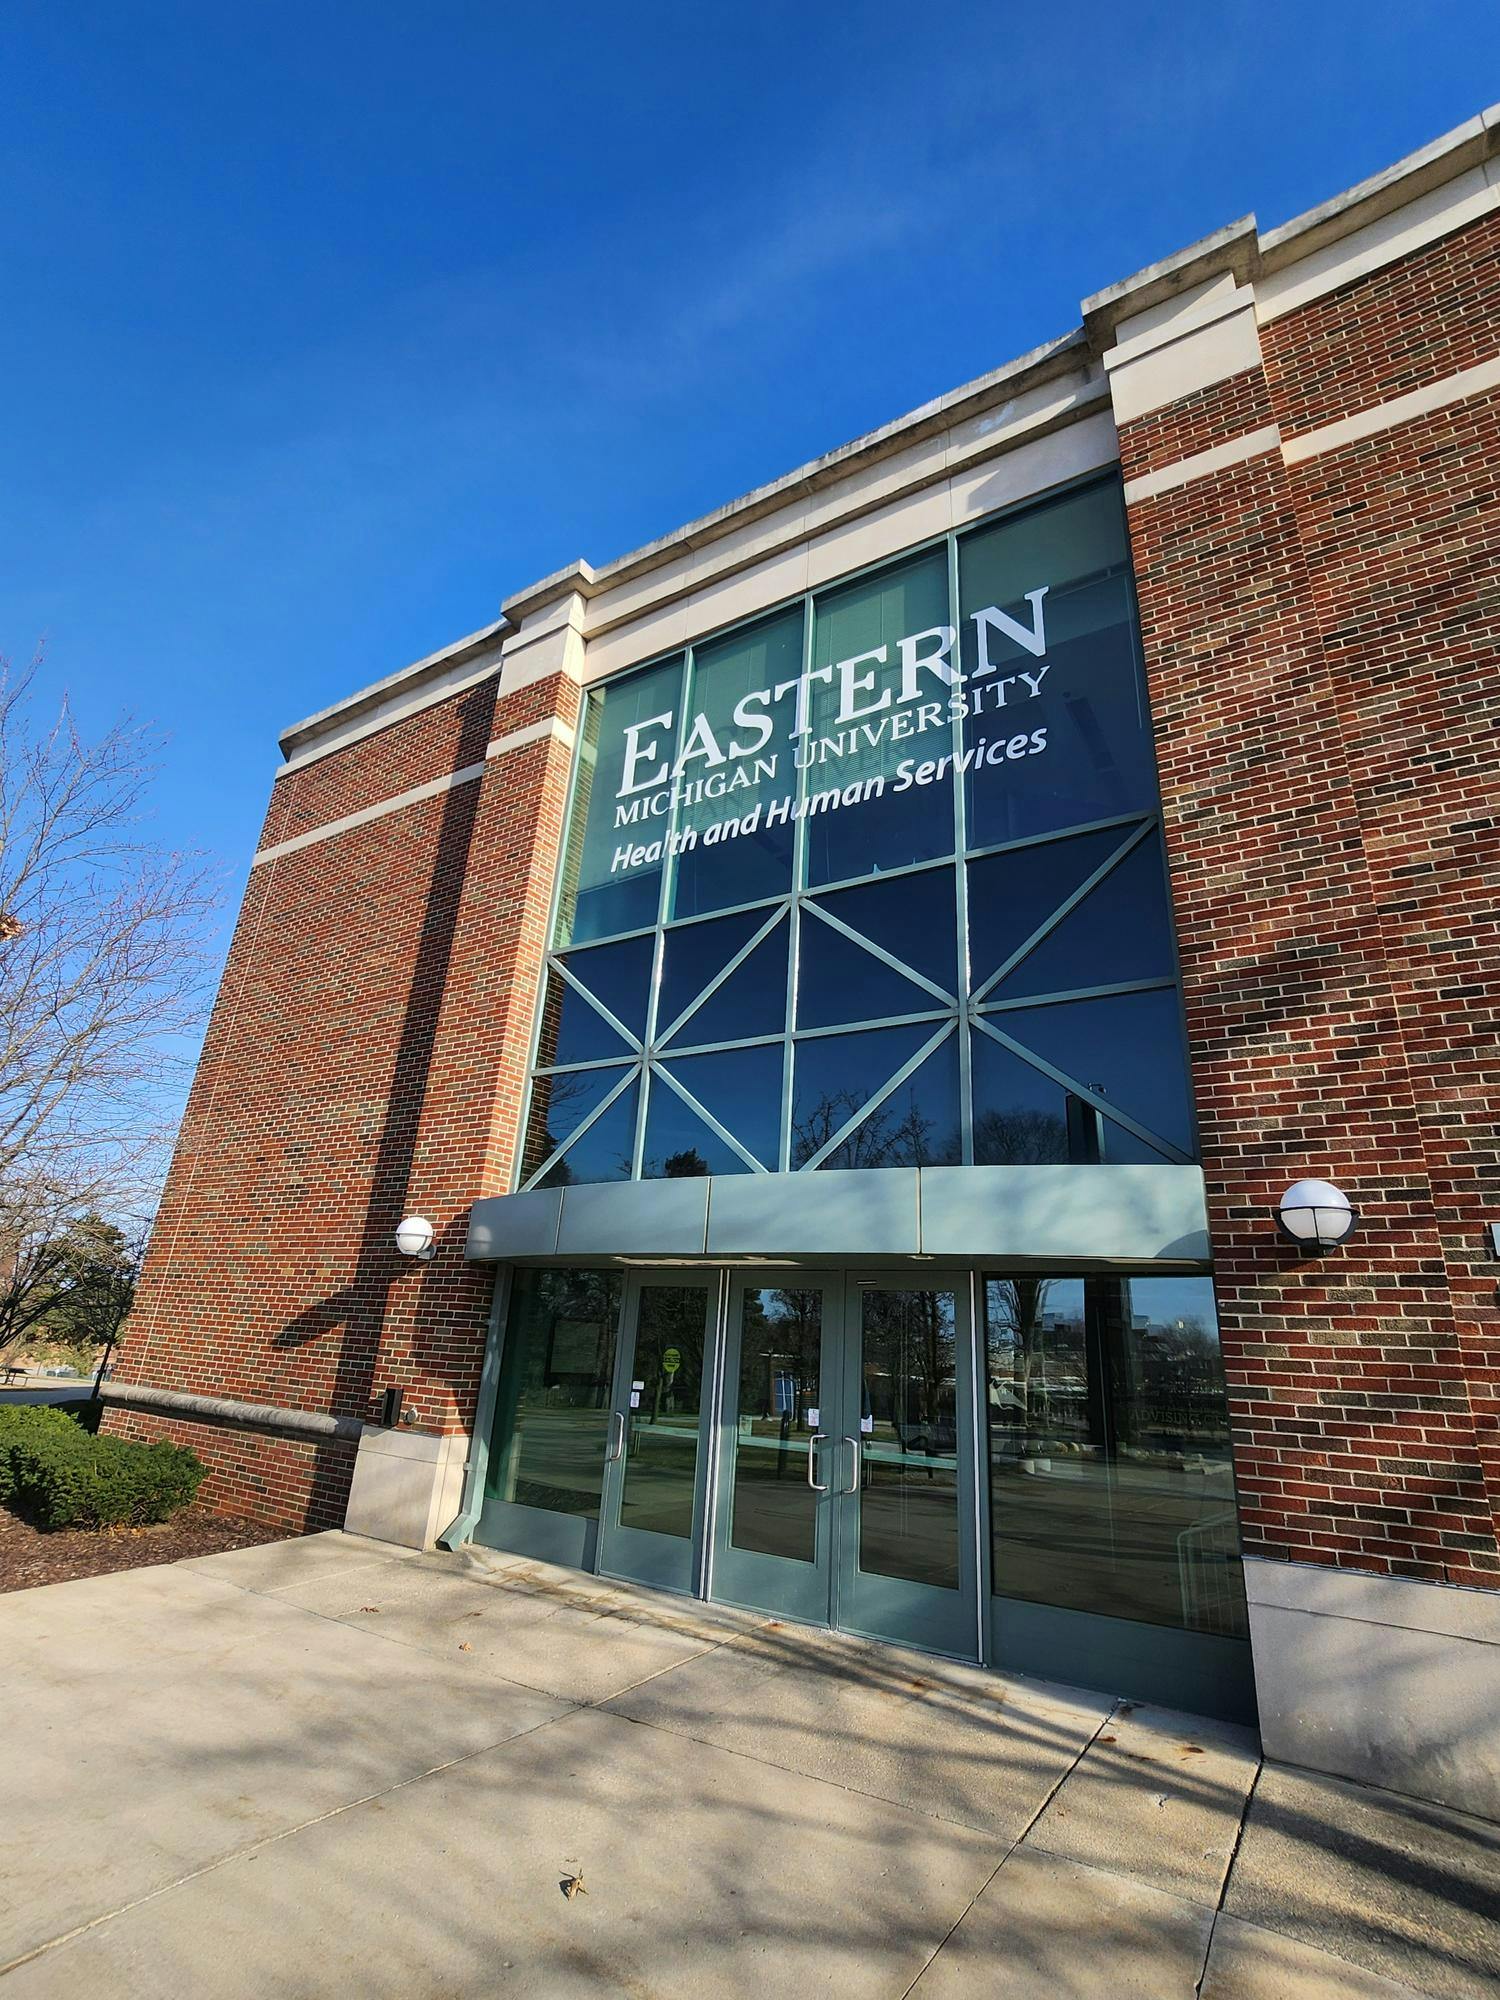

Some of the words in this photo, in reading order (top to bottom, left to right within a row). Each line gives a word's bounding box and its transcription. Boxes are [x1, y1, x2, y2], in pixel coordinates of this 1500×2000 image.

[612, 754, 778, 829] MICHIGAN
[793, 665, 1050, 770] UNIVERSITY
[615, 586, 1049, 799] EASTERN
[610, 830, 698, 873] Health
[703, 805, 761, 846] and
[765, 775, 885, 830] Human
[893, 727, 1048, 793] Services
